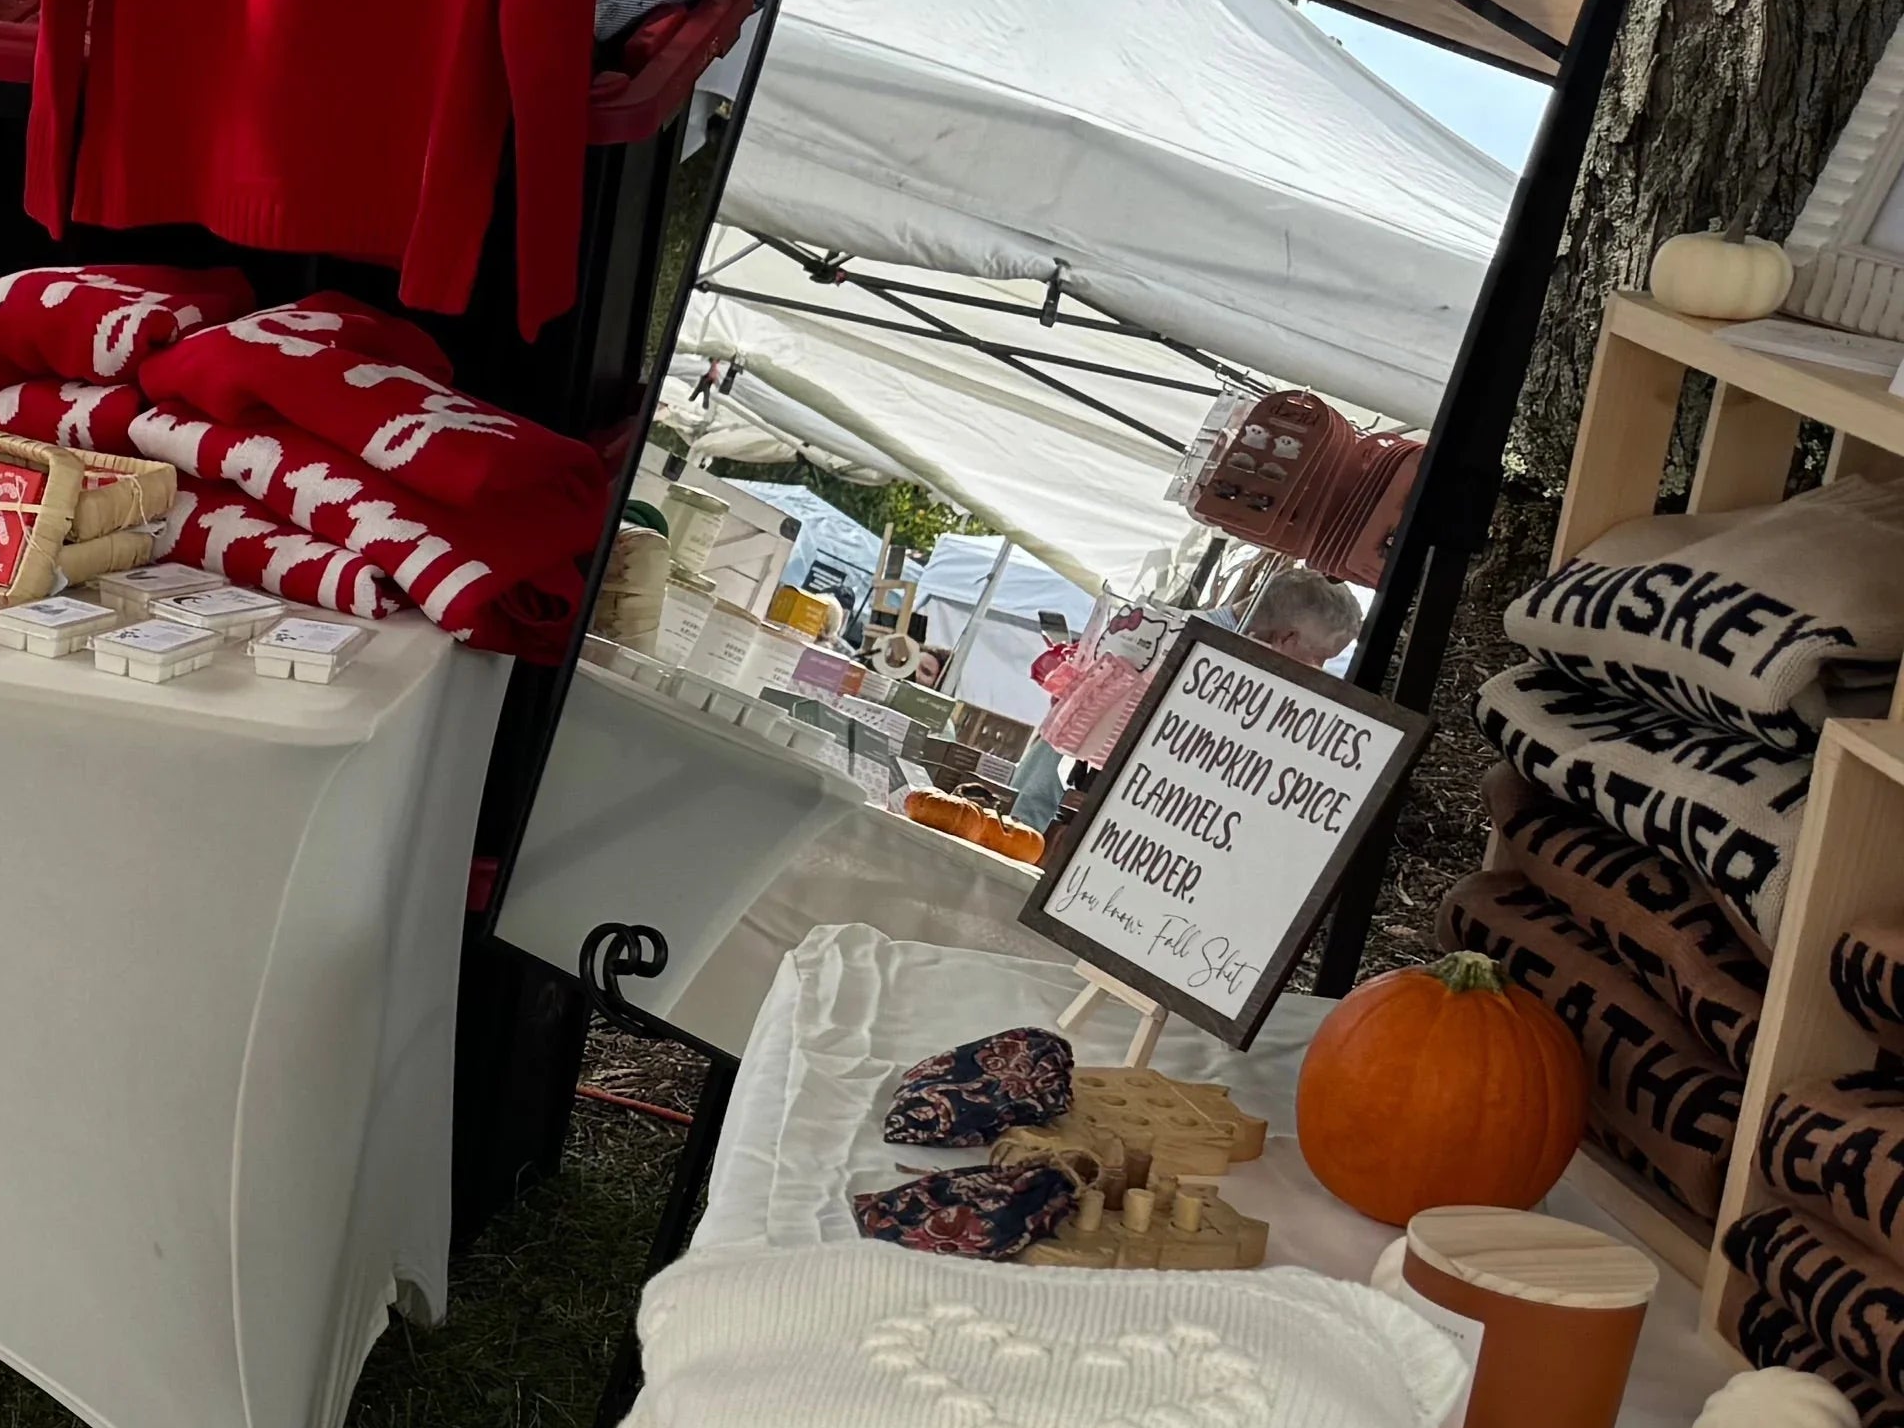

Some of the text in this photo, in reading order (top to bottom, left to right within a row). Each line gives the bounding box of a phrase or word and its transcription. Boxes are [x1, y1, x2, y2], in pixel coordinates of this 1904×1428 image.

[1182, 657, 1374, 773] SCARY MOVIES.
[1120, 761, 1243, 854] FLANNELS.
[1151, 707, 1353, 835] PUMPKIN SPICE.
[1089, 817, 1204, 905] MURDER.
